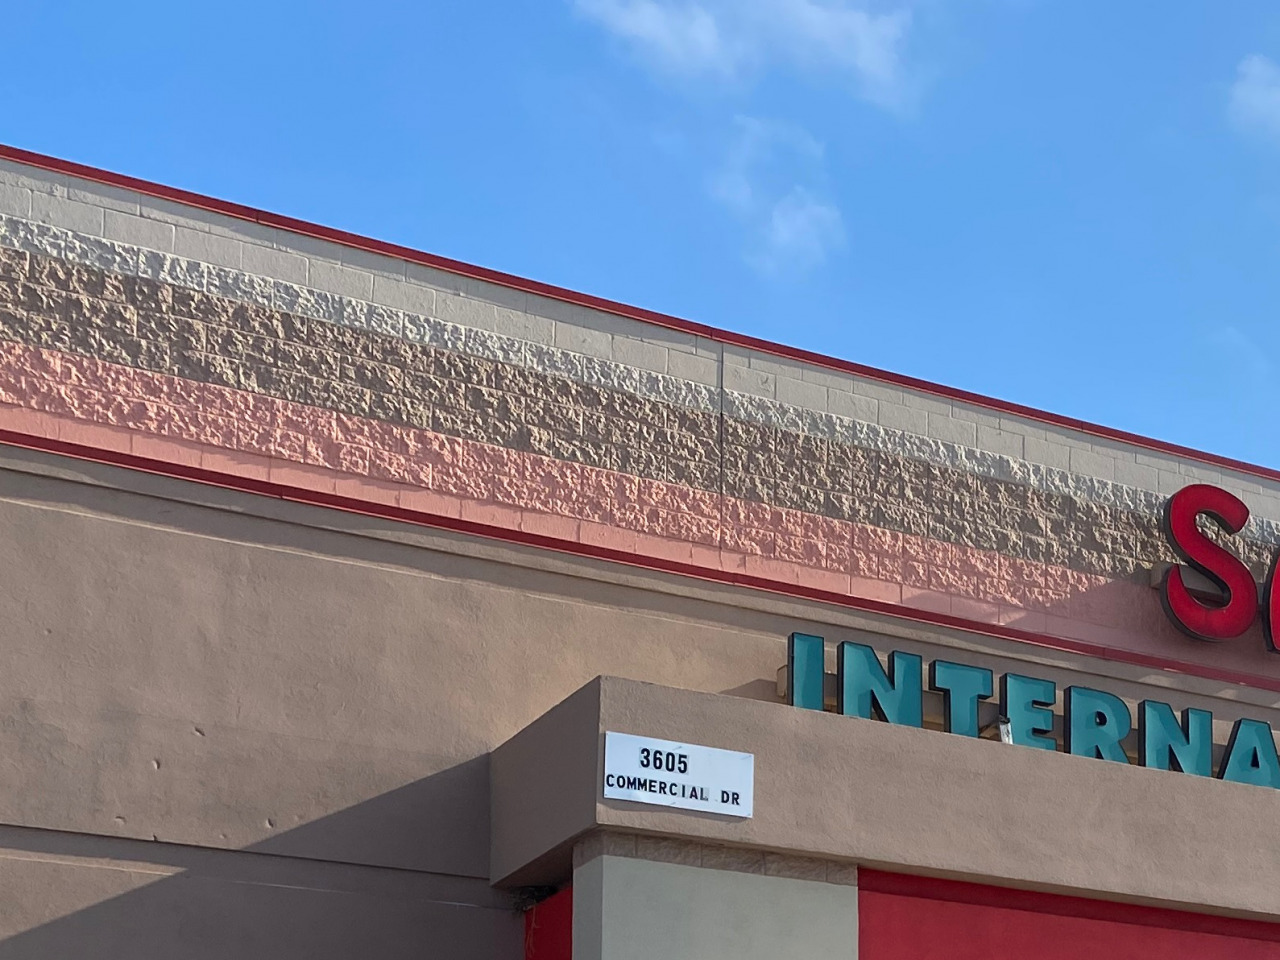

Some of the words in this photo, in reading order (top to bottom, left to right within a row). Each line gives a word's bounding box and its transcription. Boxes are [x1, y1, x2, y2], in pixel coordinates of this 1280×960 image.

[640, 748, 688, 773] 3605
[606, 774, 709, 801] COMMERCIAL
[720, 790, 741, 806] DR
